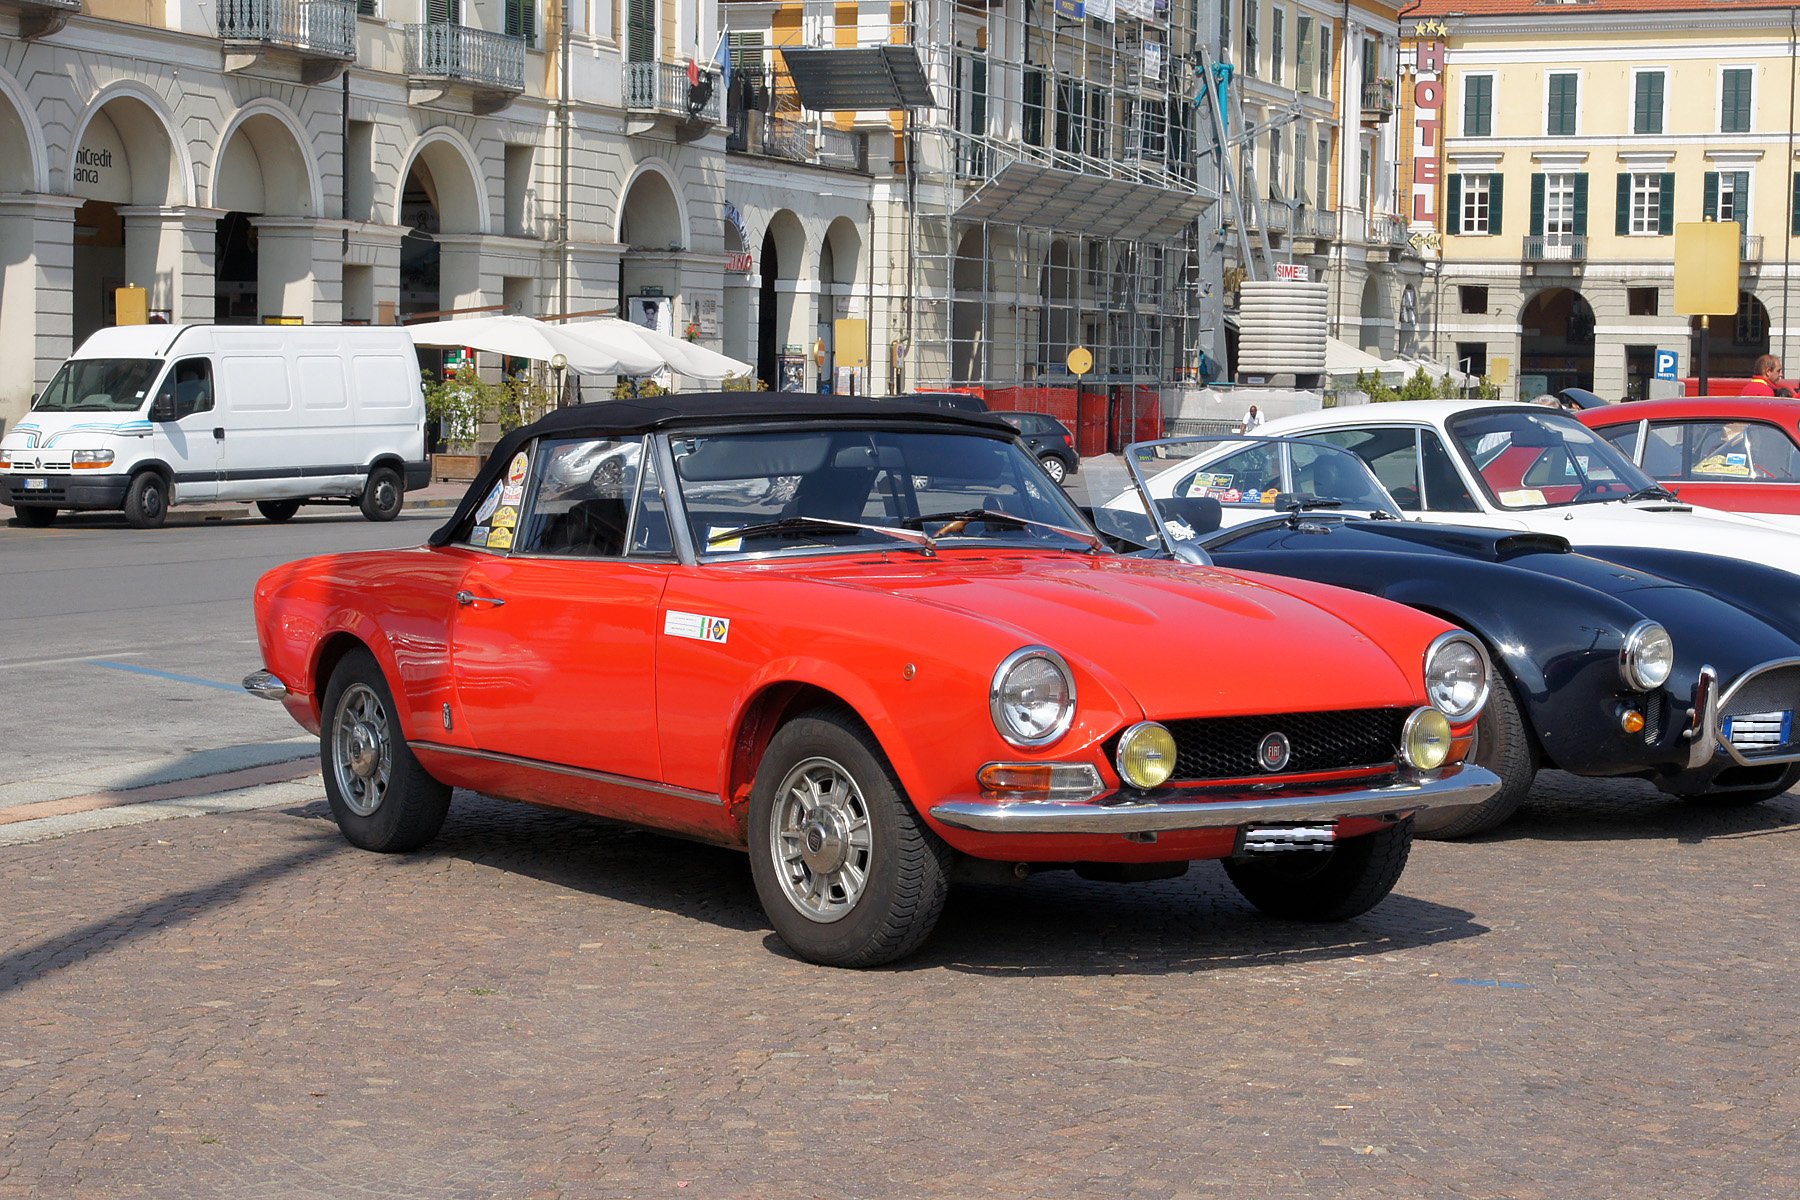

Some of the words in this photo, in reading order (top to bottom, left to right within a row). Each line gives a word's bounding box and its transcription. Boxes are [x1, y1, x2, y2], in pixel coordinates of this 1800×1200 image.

[1414, 42, 1444, 221] HOTEL
[76, 147, 112, 168] niCredit
[73, 168, 98, 183] anca
[1277, 264, 1298, 279] SIME
[1658, 354, 1675, 373] P
[1268, 745, 1280, 757] FIAT
